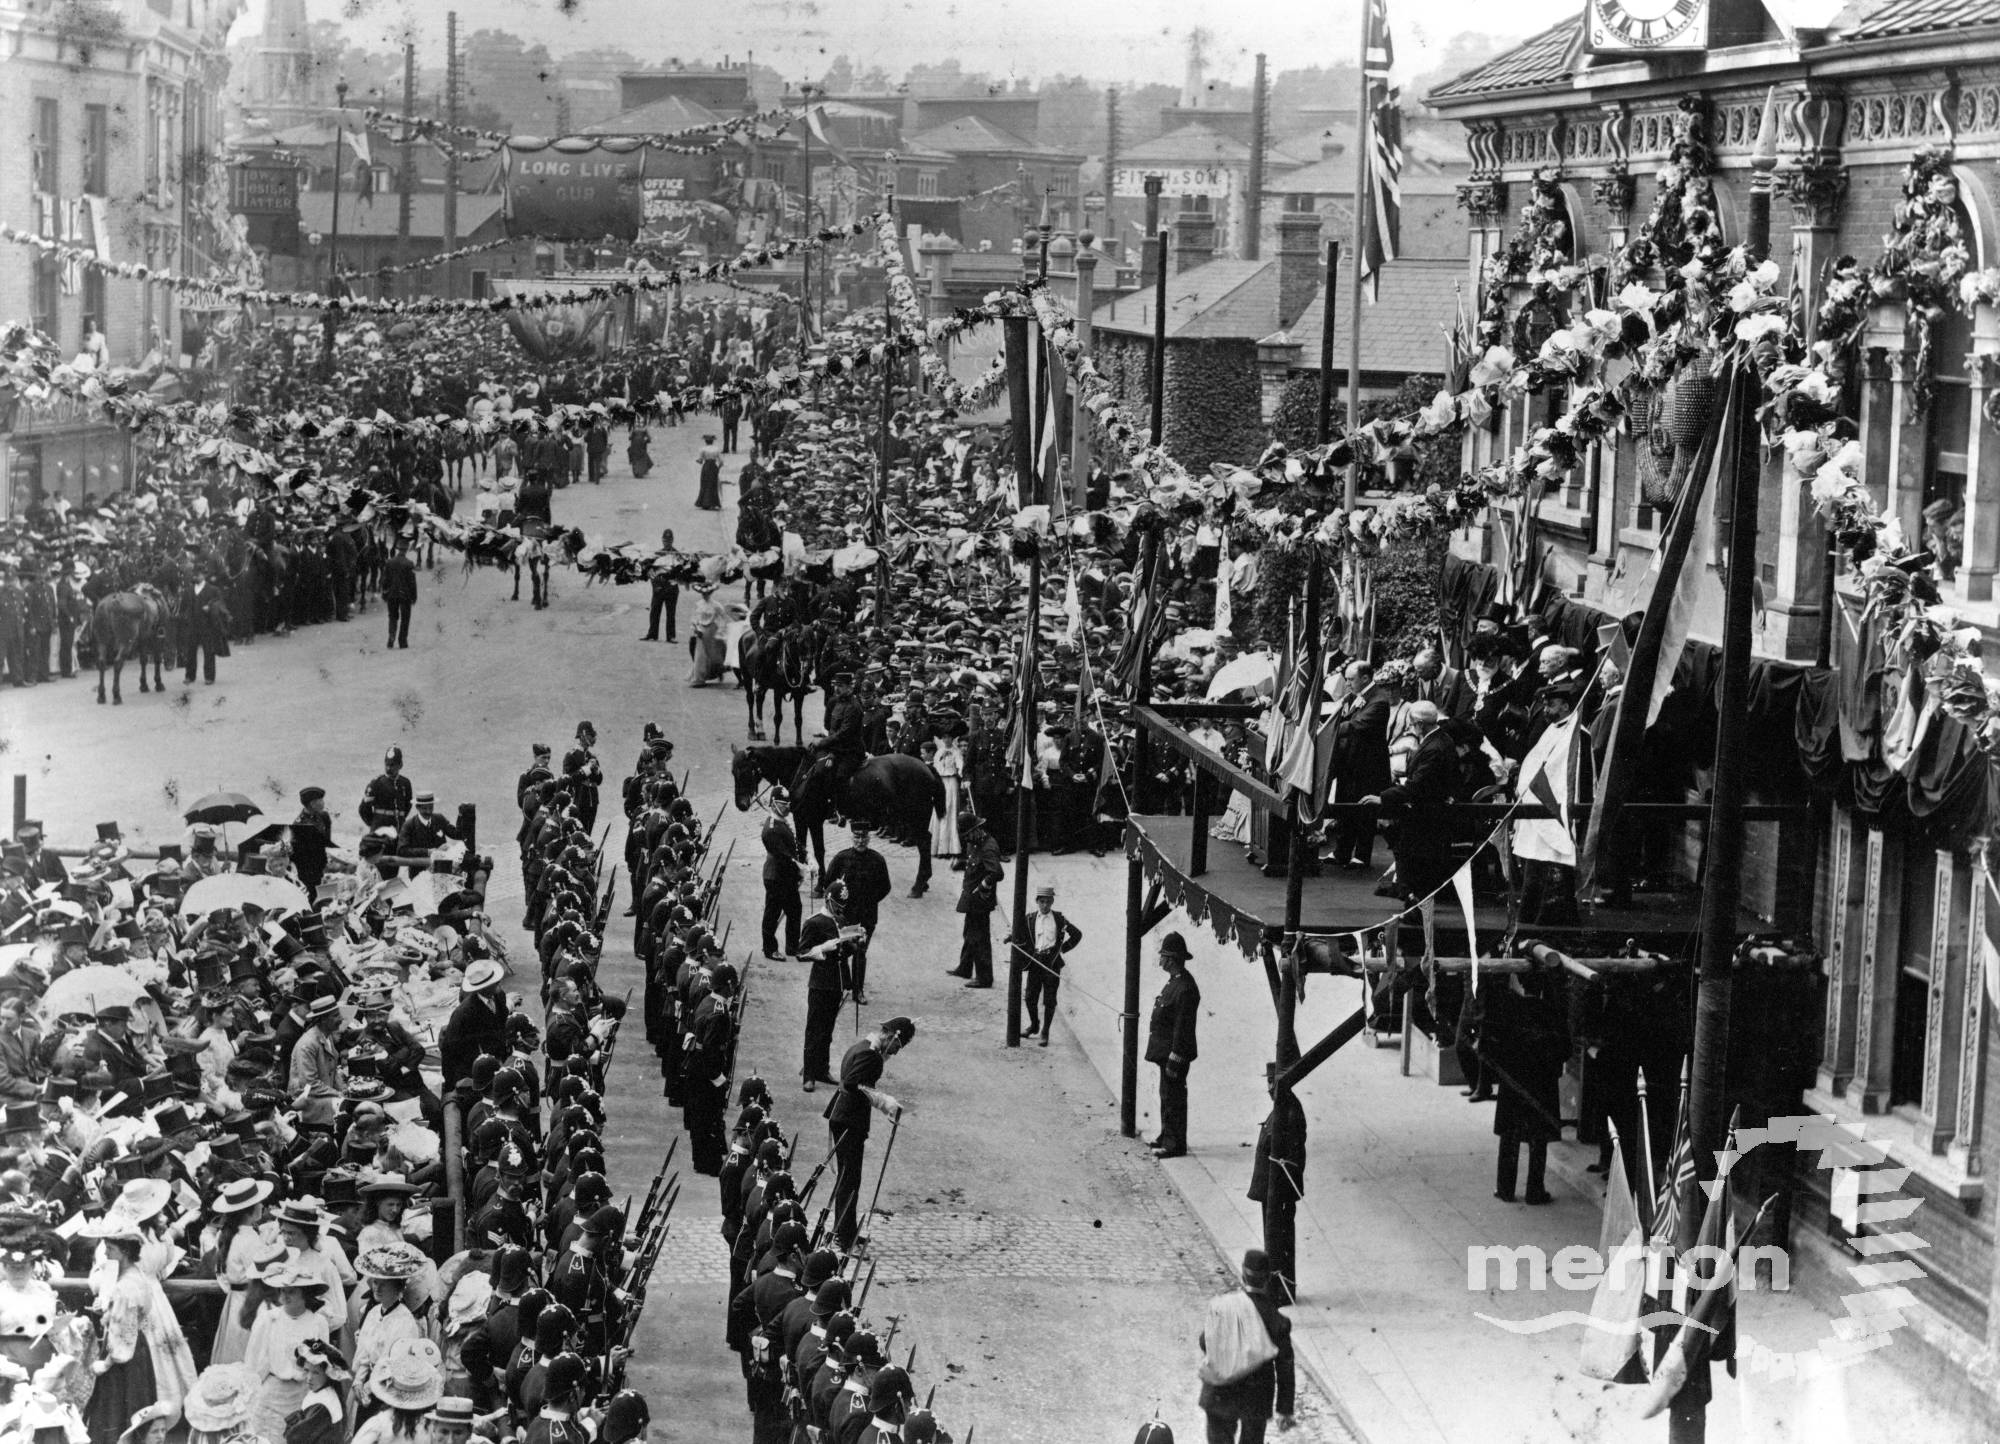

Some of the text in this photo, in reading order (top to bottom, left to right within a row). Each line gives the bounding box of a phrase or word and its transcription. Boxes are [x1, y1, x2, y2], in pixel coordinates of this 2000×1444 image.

[520, 161, 627, 178] LONG LIVE
[644, 178, 685, 190] OFFICE
